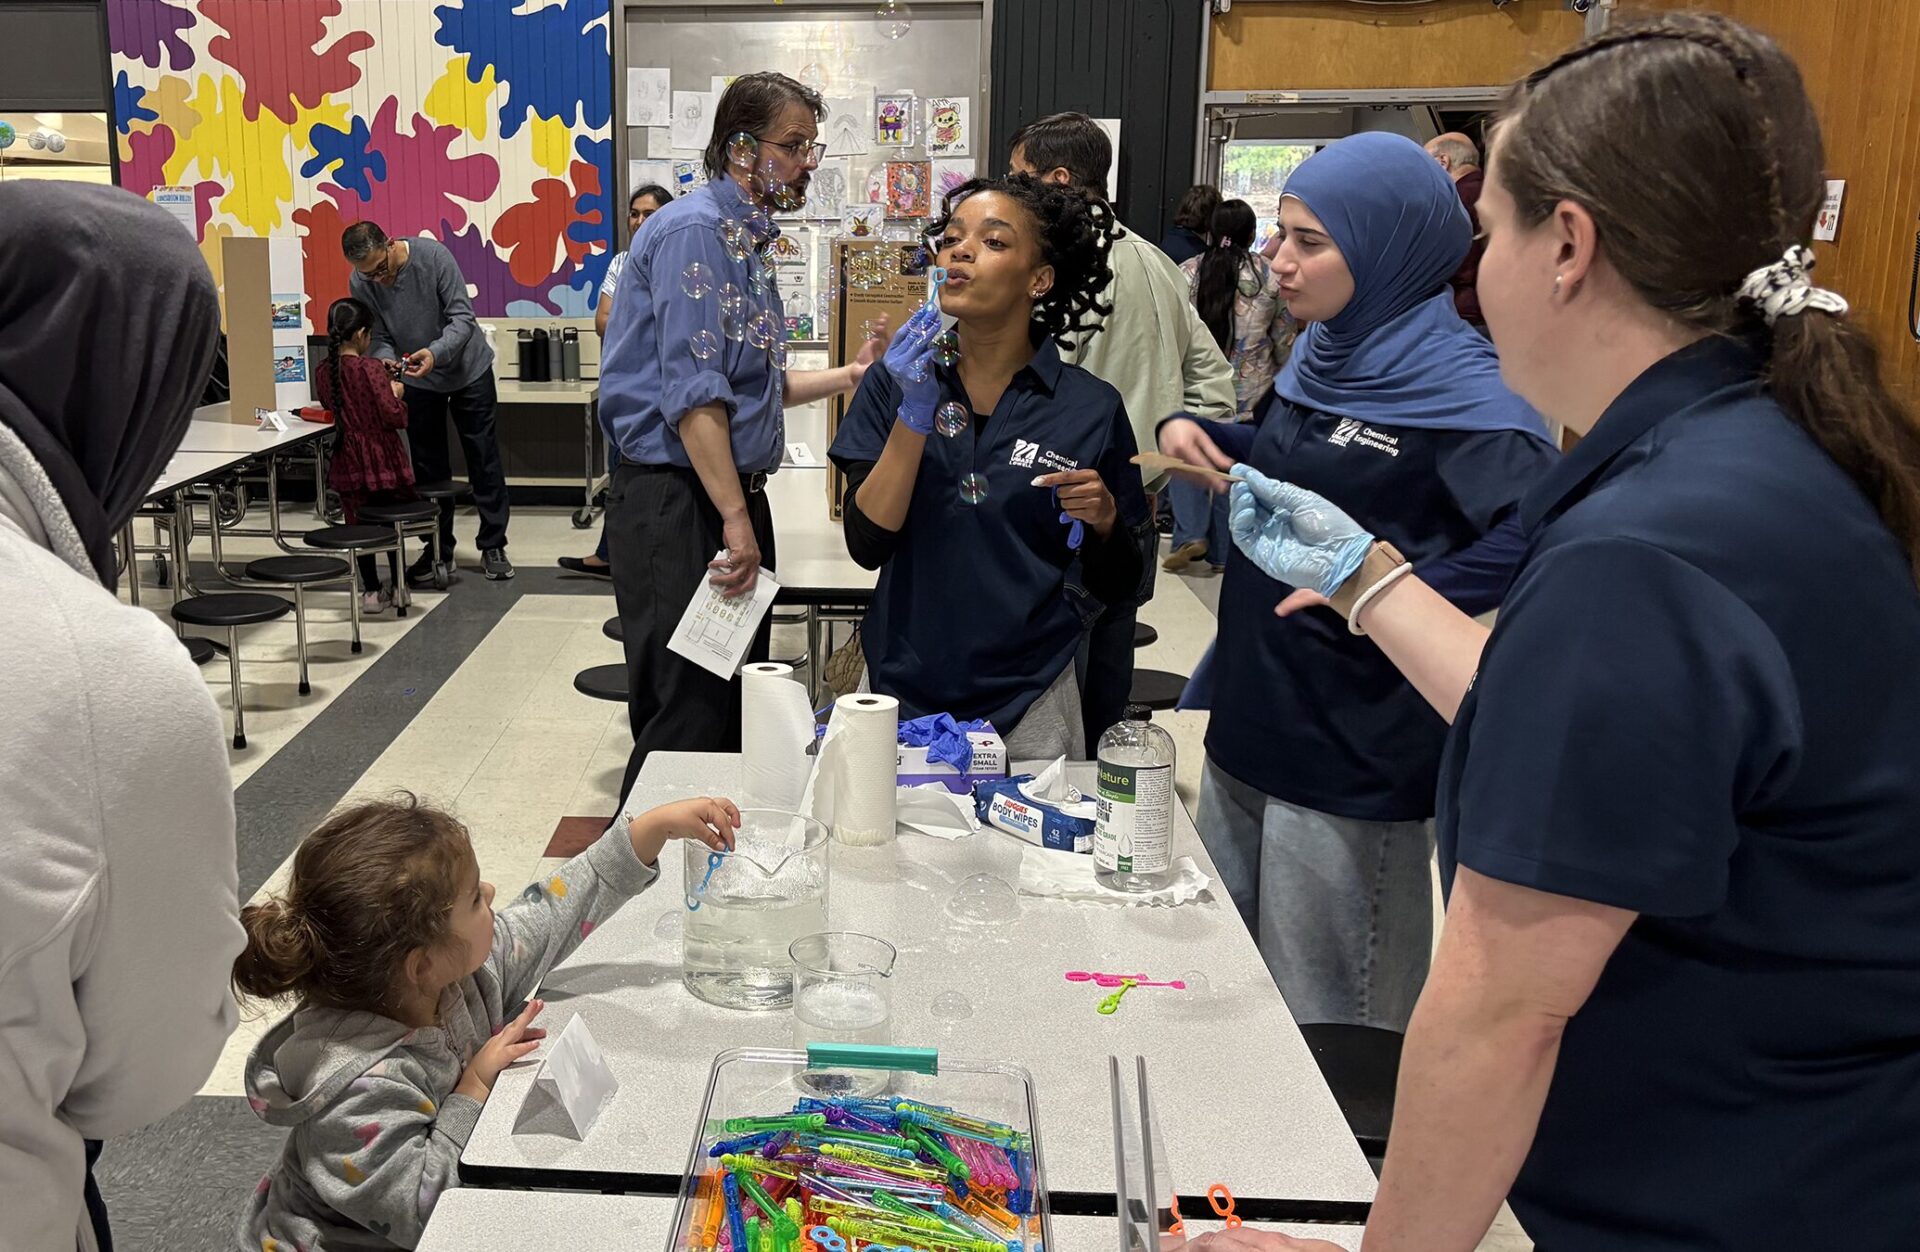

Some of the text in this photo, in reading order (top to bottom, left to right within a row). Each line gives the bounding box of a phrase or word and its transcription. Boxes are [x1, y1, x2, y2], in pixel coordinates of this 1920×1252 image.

[1363, 427, 1399, 445] Chemical
[795, 446, 805, 458] 2
[1353, 434, 1400, 457] Engineering
[1045, 450, 1079, 468] Chemical
[992, 802, 1012, 818] BODY
[1013, 811, 1038, 829] WIPES
[1051, 828, 1060, 838] 42
